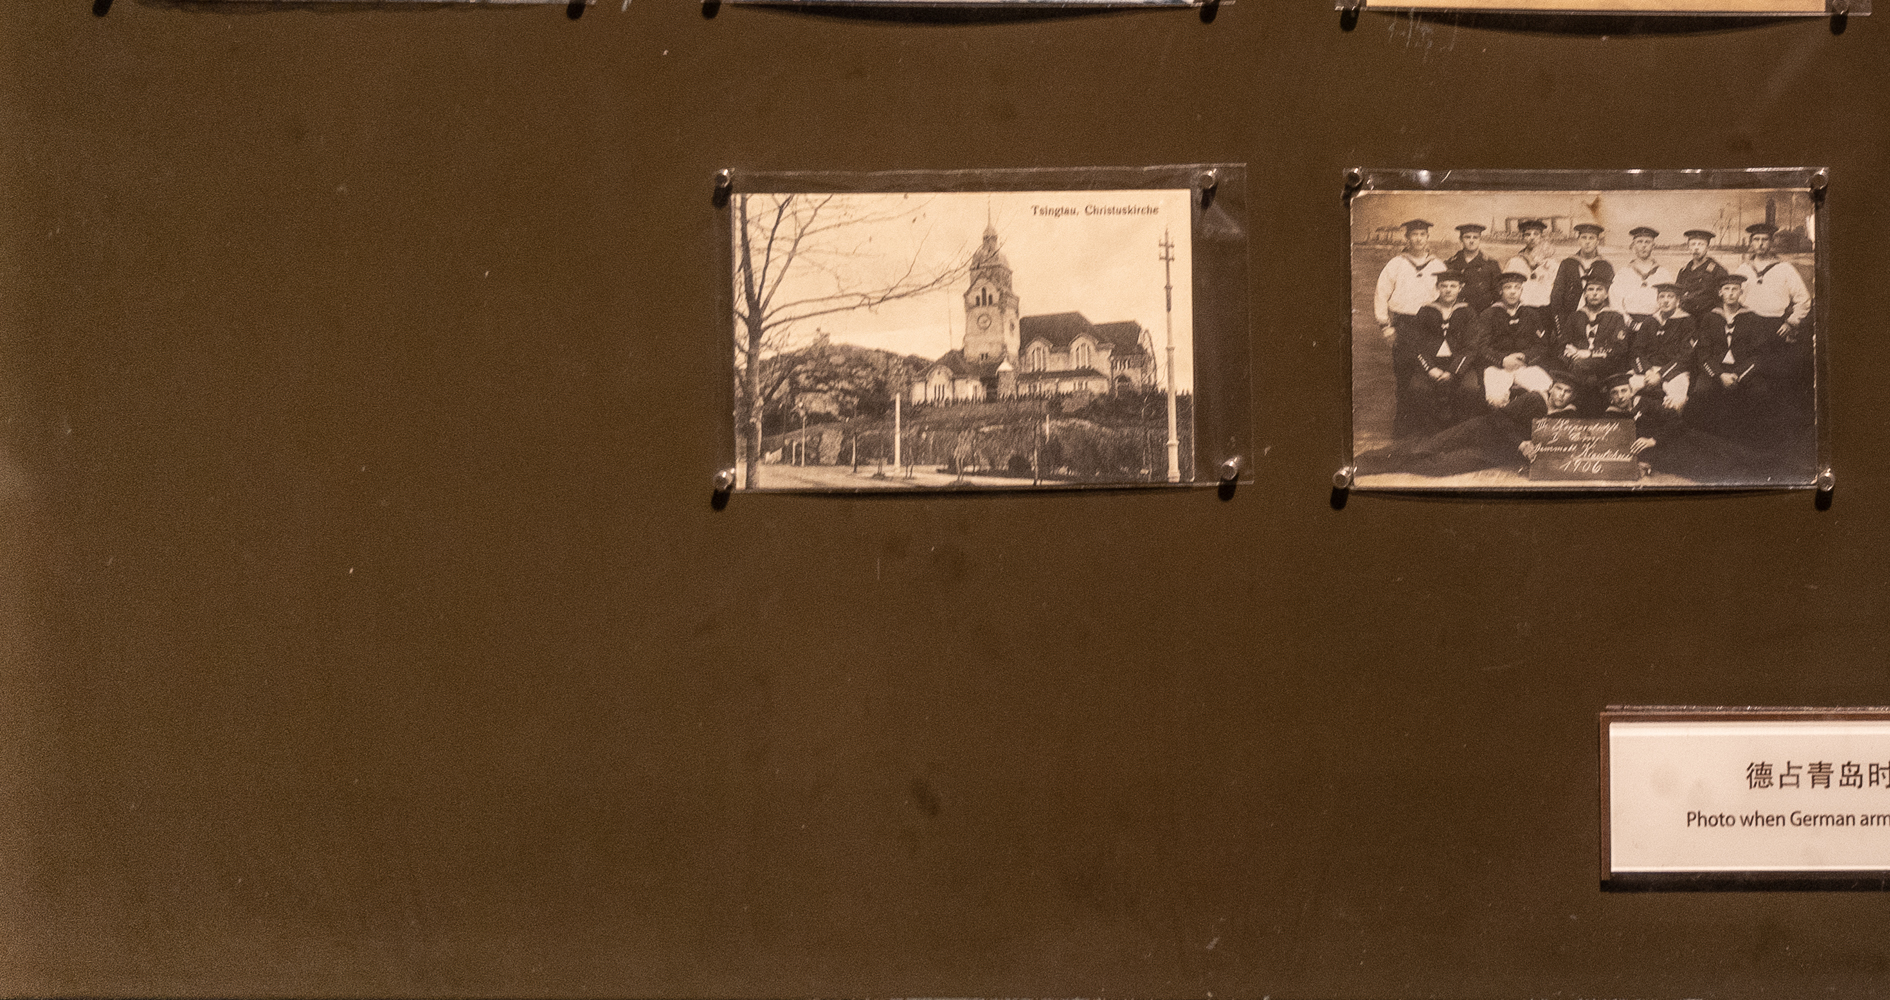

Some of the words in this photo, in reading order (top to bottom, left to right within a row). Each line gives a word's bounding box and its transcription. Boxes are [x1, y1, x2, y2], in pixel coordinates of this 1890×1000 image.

[1031, 204, 1079, 217] Tsingtau,
[1084, 204, 1159, 216] Christuskirche
[1686, 811, 1736, 828] Photo
[1740, 810, 1786, 828] when
[1790, 810, 1856, 828] German
